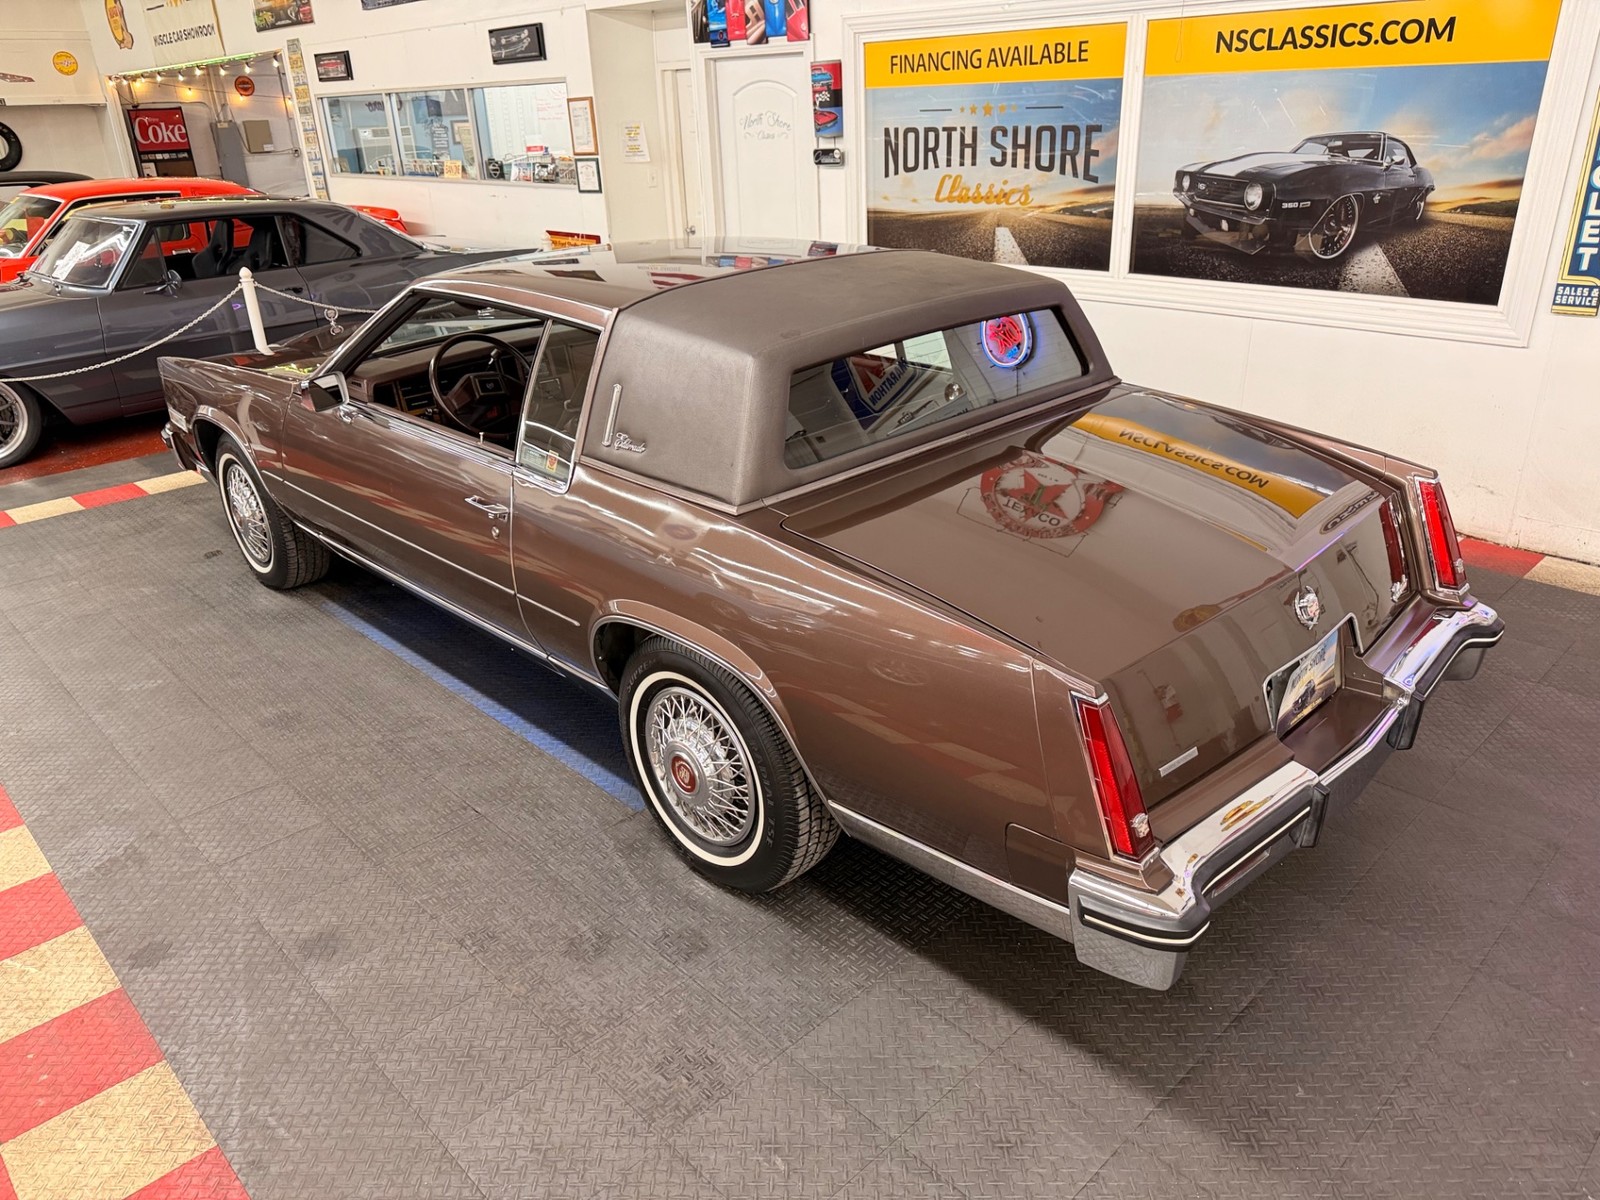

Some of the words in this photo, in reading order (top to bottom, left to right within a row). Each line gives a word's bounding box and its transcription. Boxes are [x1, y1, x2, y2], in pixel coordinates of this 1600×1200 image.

[172, 29, 184, 43] CAR
[183, 23, 216, 41] SHOWROOM
[1215, 16, 1456, 54] NSCLASSICS.COM
[890, 49, 982, 75] FINANCING
[987, 40, 1089, 68] AVAILABLE
[134, 117, 188, 144] Coke
[884, 126, 978, 178] NORTH
[990, 124, 1103, 184] SHORE
[934, 174, 1034, 206] Classics
[1555, 295, 1598, 306] SERVICE
[1557, 286, 1589, 296] SALES
[1591, 288, 1599, 297] &
